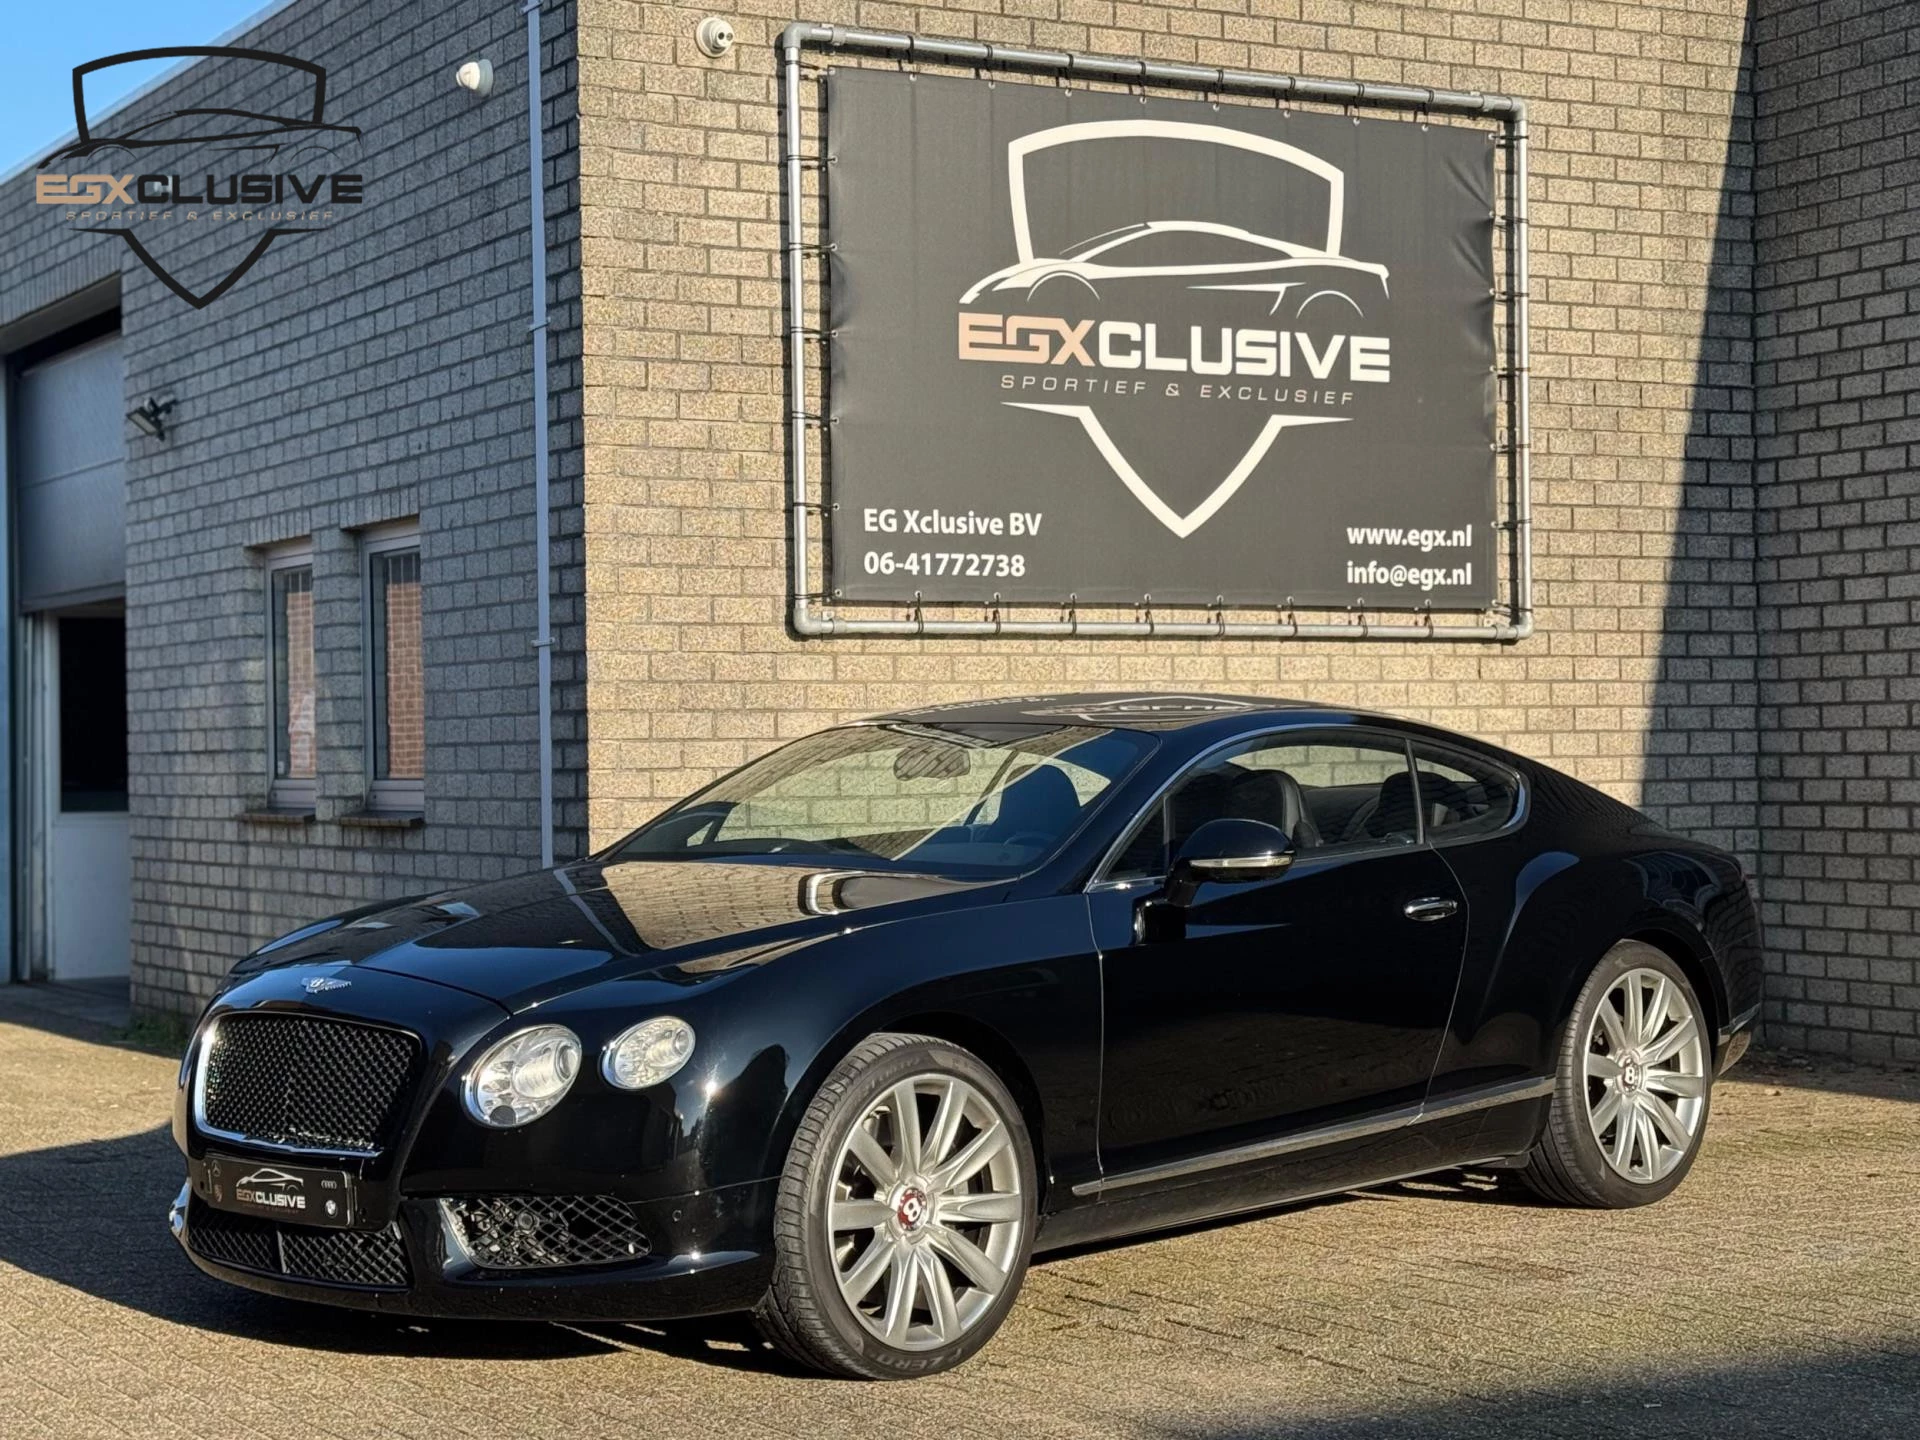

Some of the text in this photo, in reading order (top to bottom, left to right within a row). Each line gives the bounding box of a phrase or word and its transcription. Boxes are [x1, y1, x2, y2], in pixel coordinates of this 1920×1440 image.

[958, 311, 1391, 384] EGXCLUSIVE
[1000, 374, 1354, 406] SPORTIEF & EXCLUSIEF
[863, 508, 1043, 536] EG Xclusive BV
[1346, 523, 1473, 553] www.egx.nl
[863, 551, 1026, 578] 06-41772738
[1346, 559, 1473, 592] info@egx.nl
[235, 1188, 306, 1209] EGXCLUSIVE
